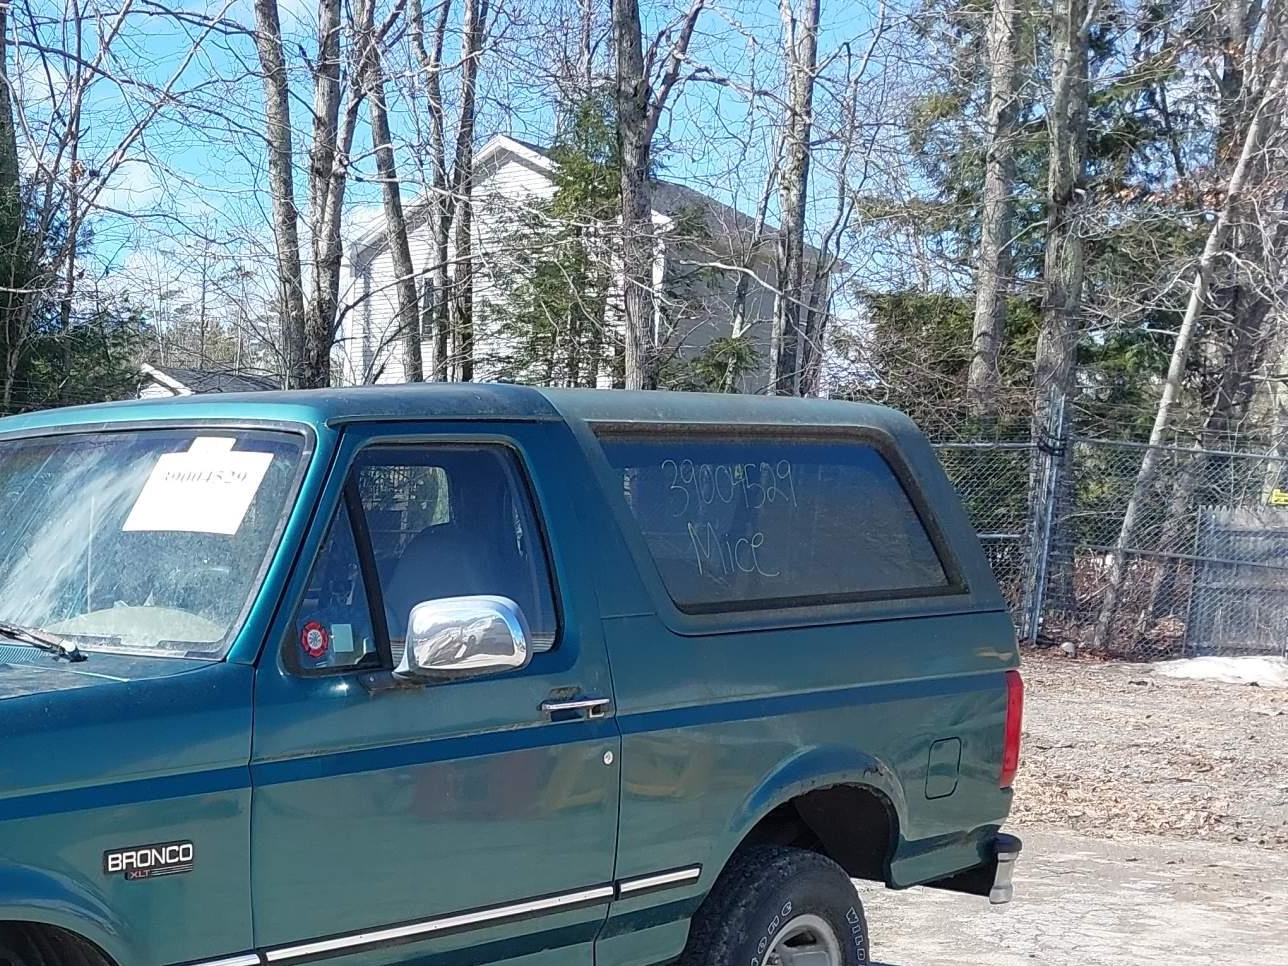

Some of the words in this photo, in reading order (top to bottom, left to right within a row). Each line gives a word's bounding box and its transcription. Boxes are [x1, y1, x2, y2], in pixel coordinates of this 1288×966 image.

[661, 458, 798, 518] 39004529
[687, 521, 781, 578] Mice
[107, 843, 194, 873] BRONCO
[129, 869, 151, 880] XLT
